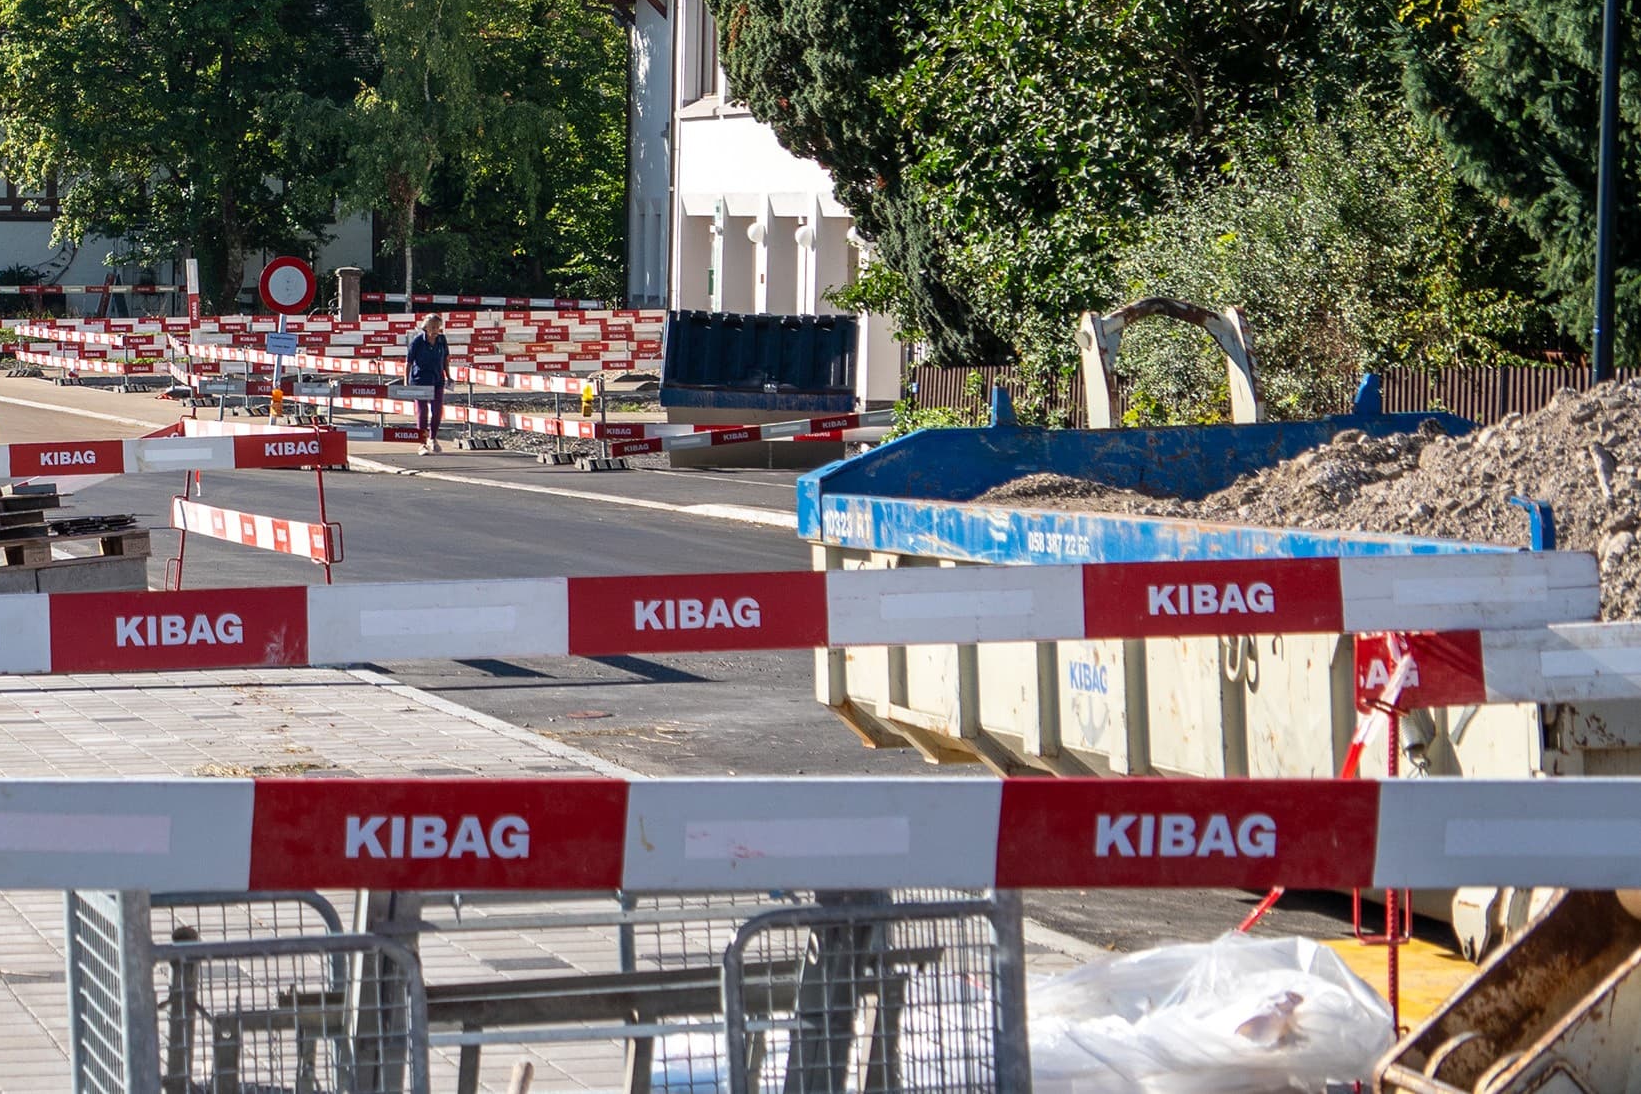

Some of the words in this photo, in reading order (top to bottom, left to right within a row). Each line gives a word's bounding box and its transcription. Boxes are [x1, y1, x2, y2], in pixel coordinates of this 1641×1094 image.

[723, 432, 749, 441] KIBAG
[822, 419, 847, 428] KIBAG
[40, 450, 96, 466] KIBAG
[265, 440, 319, 456] KIBAG
[624, 443, 649, 452] KIBAG
[1028, 531, 1044, 553] 058
[1046, 532, 1062, 556] 387
[1064, 534, 1076, 555] 22
[1078, 536, 1089, 555] 66
[1148, 582, 1274, 615] KIBAG
[634, 597, 760, 630] KIBAG
[116, 613, 243, 647] KIBAG
[1069, 661, 1108, 694] KIBAG
[345, 816, 530, 859] KIBAG
[1095, 814, 1276, 857] KIBAG
